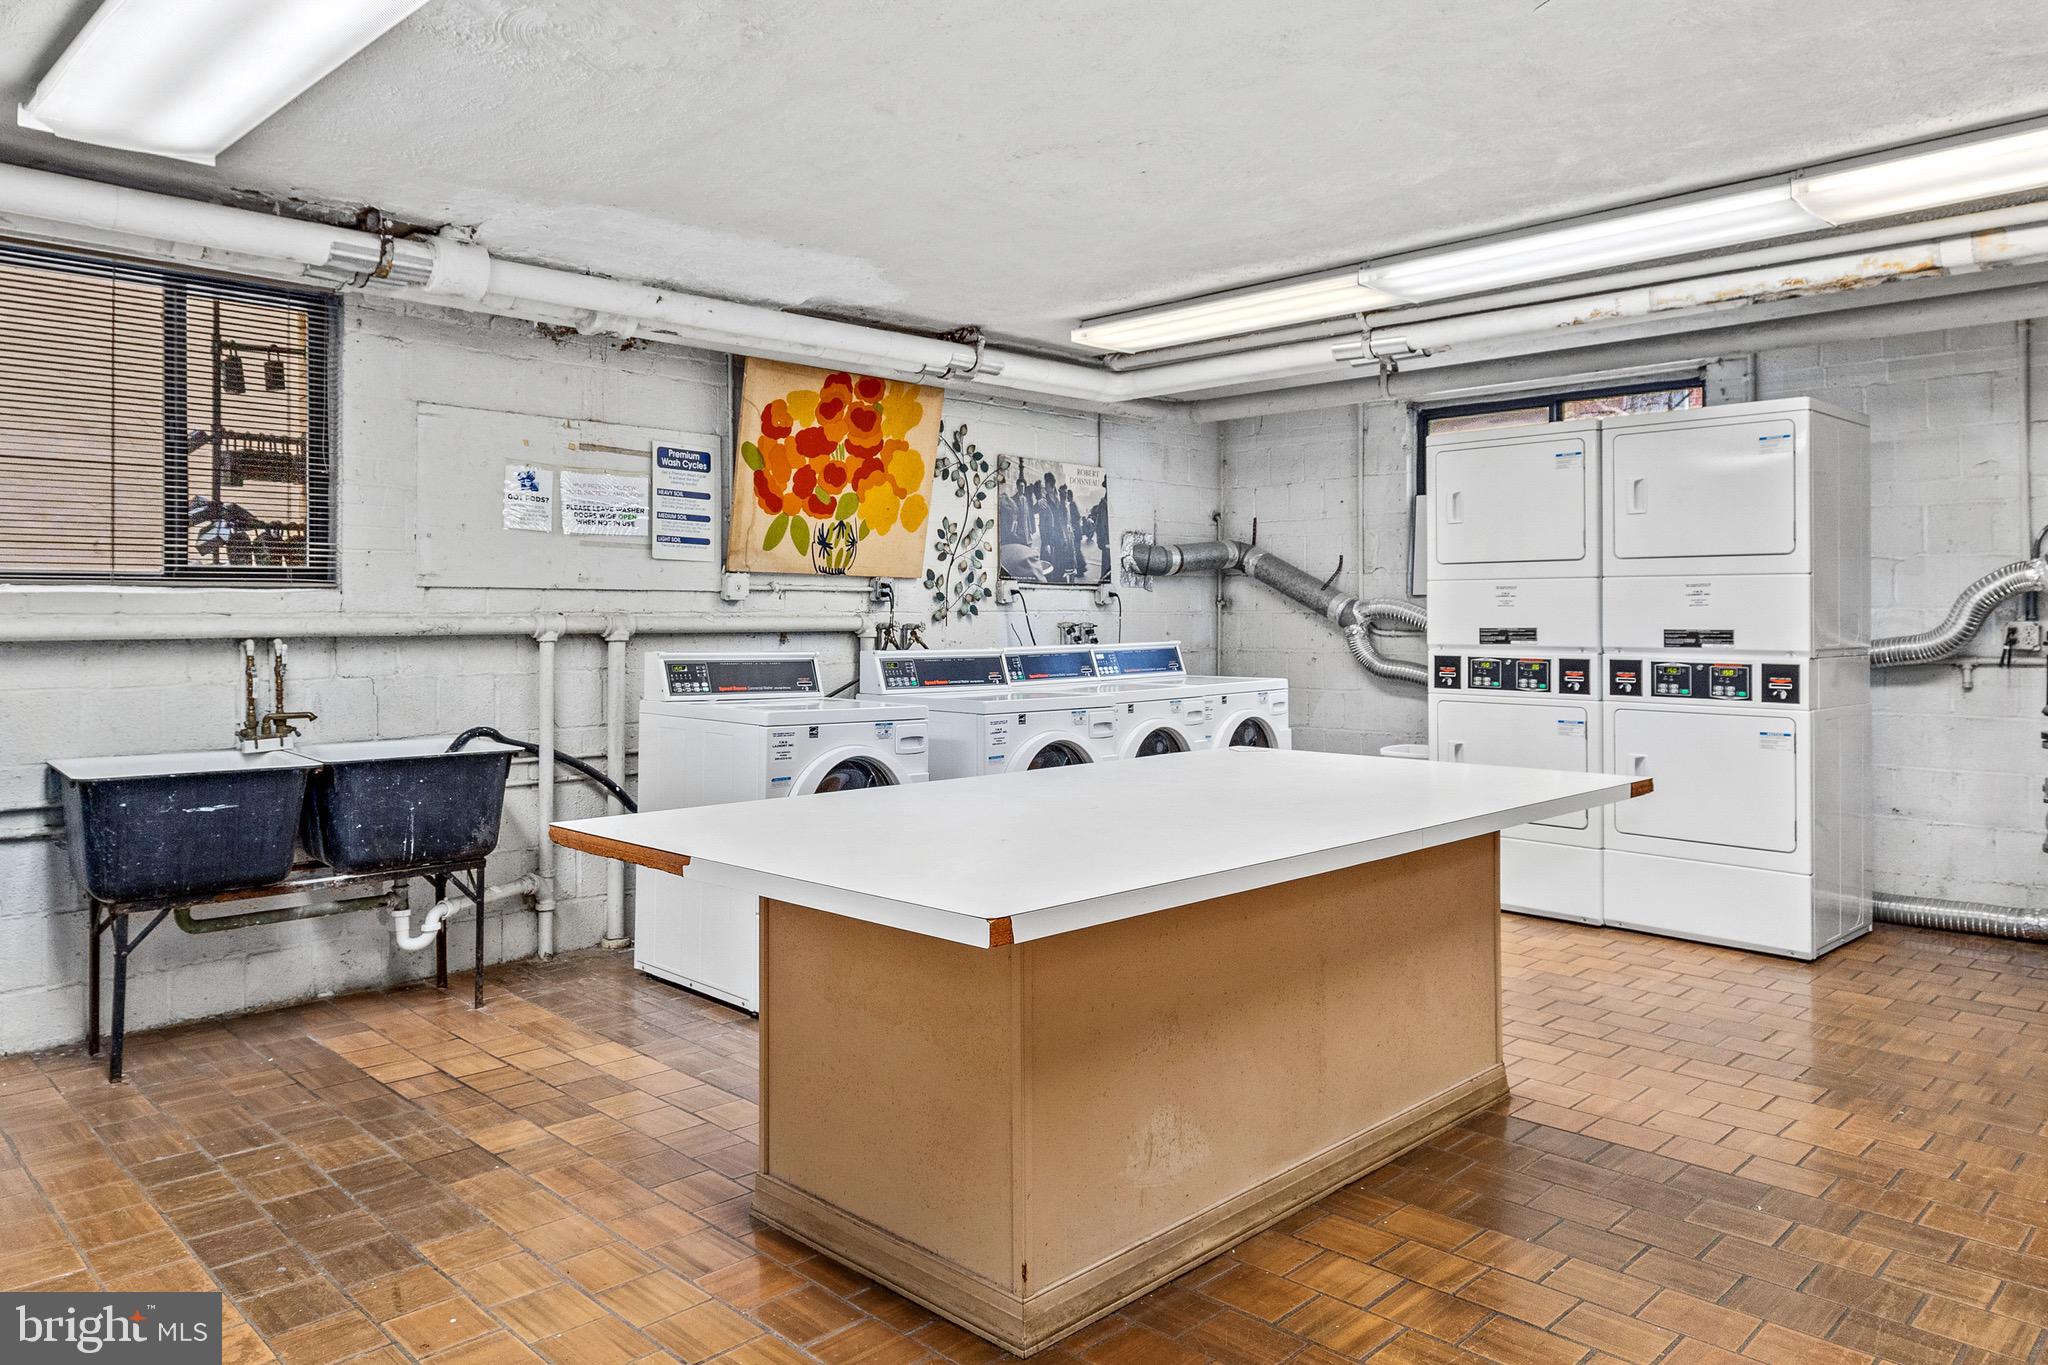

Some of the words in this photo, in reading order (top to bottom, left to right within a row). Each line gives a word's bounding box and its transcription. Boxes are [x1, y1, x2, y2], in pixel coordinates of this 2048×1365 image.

[668, 449, 700, 460] Premium
[661, 457, 681, 467] Wash
[682, 460, 707, 470] Cycles
[616, 506, 645, 514] WASHER
